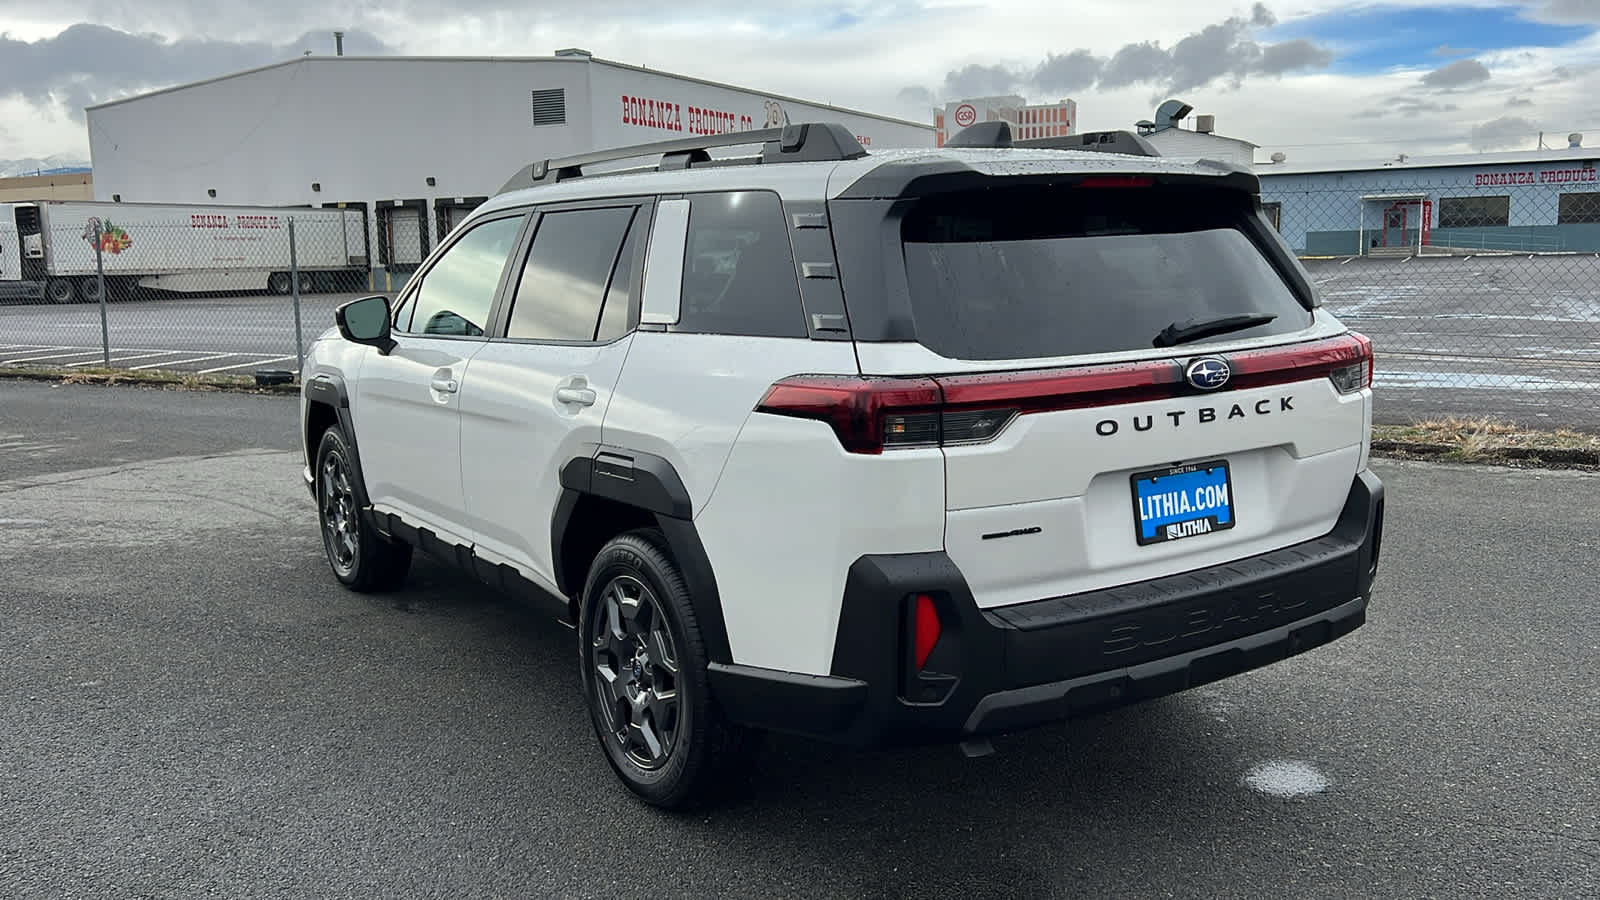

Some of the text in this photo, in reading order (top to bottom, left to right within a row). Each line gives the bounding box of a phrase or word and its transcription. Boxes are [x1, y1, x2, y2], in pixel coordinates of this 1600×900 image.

[622, 95, 682, 132] BONANZA
[688, 106, 736, 135] PRODUCE
[957, 111, 973, 121] GSR
[1475, 168, 1596, 186] BONANZA PRODUCE
[191, 214, 229, 229] BONANZA
[237, 215, 268, 229] PRODUCE
[1095, 396, 1294, 436] OUTBACK
[1169, 467, 1184, 475] SINCE
[1138, 483, 1229, 521] LITHIA.COM
[1176, 518, 1212, 538] LITHIA
[1104, 590, 1312, 655] SUBARU
